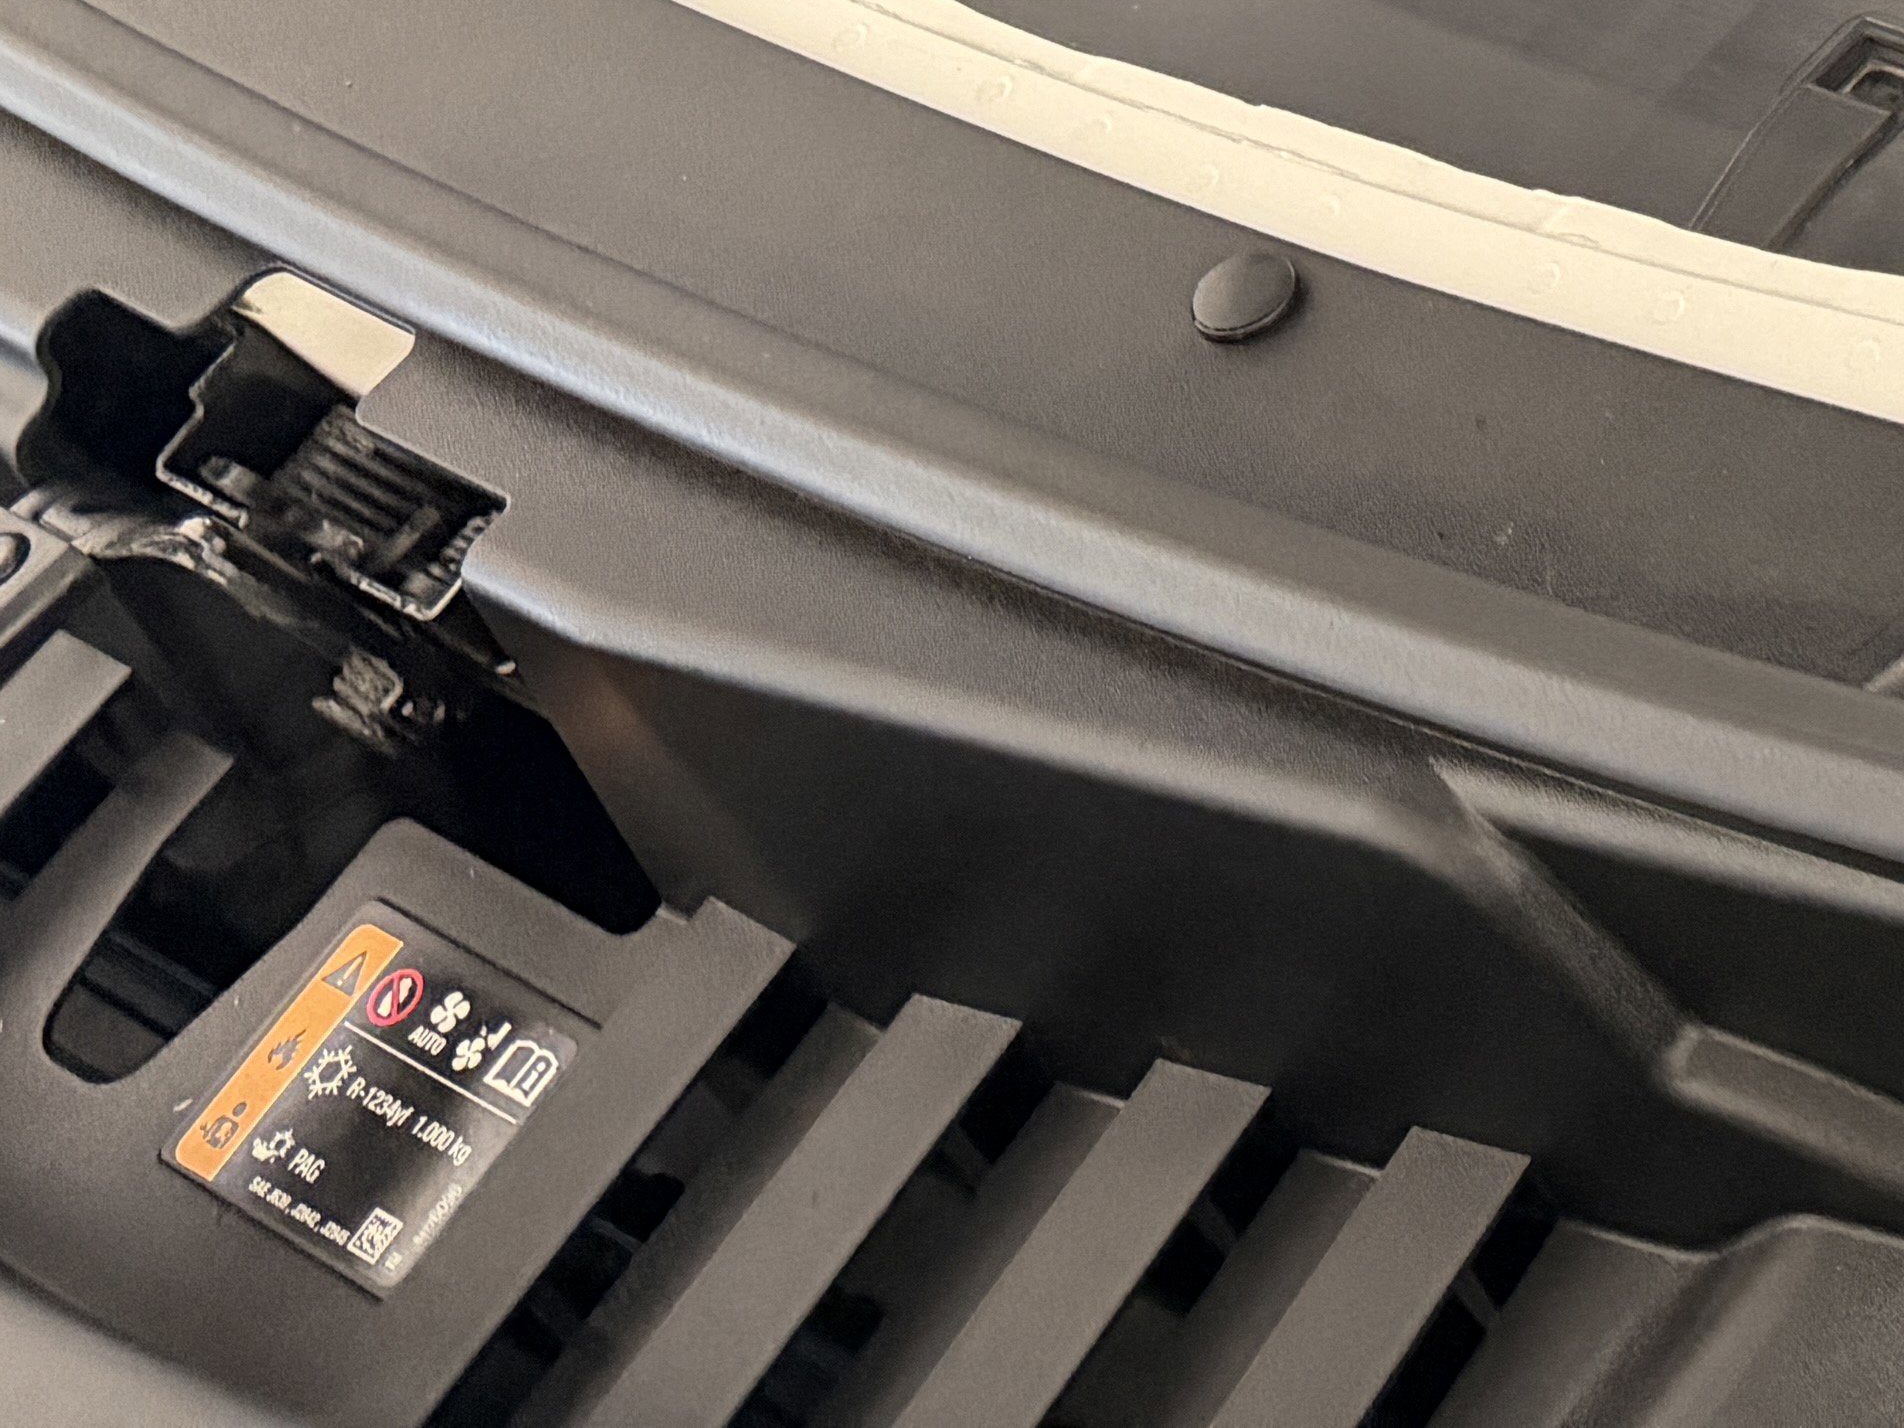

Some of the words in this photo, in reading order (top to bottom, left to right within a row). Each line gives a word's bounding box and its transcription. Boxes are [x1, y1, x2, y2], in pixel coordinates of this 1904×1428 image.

[408, 1025, 448, 1056] AUTO
[346, 1077, 416, 1127] R-1234yf
[411, 1115, 457, 1148] 1.000
[448, 1135, 473, 1167] kg
[287, 1147, 326, 1184] PAG
